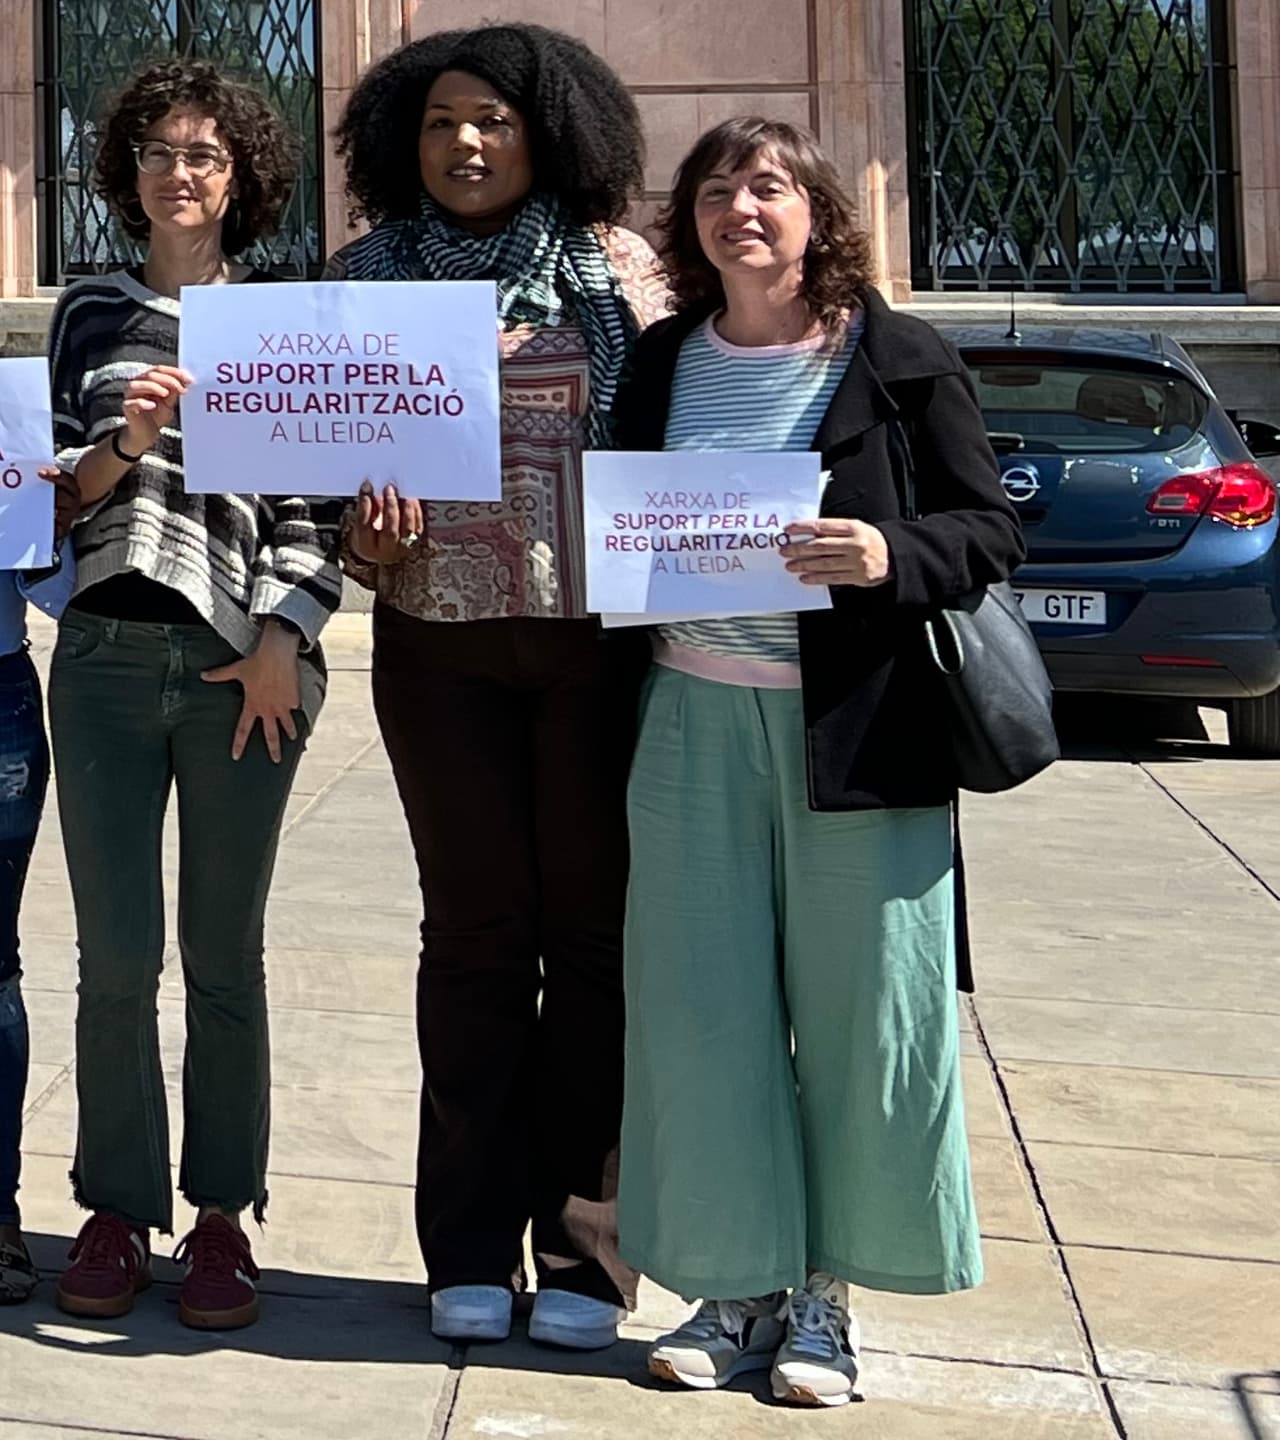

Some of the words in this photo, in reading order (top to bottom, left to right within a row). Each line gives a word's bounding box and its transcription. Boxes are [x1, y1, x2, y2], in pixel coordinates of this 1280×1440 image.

[257, 333, 354, 355] XARXA
[364, 334, 400, 356] DE
[216, 362, 334, 384] SUPORT
[344, 363, 398, 385] PER
[408, 365, 445, 386] LA
[206, 389, 464, 416] REGULARITZACIÓ
[269, 421, 289, 442] A
[298, 422, 395, 444] LLEIDA
[645, 492, 717, 509] XARXA
[724, 493, 751, 509] DE
[613, 513, 702, 530] SUPORT
[707, 514, 748, 528] PER
[753, 514, 780, 528] LA
[654, 558, 668, 574] A
[676, 556, 745, 574] LLEIDA
[1044, 594, 1094, 619] GTF
